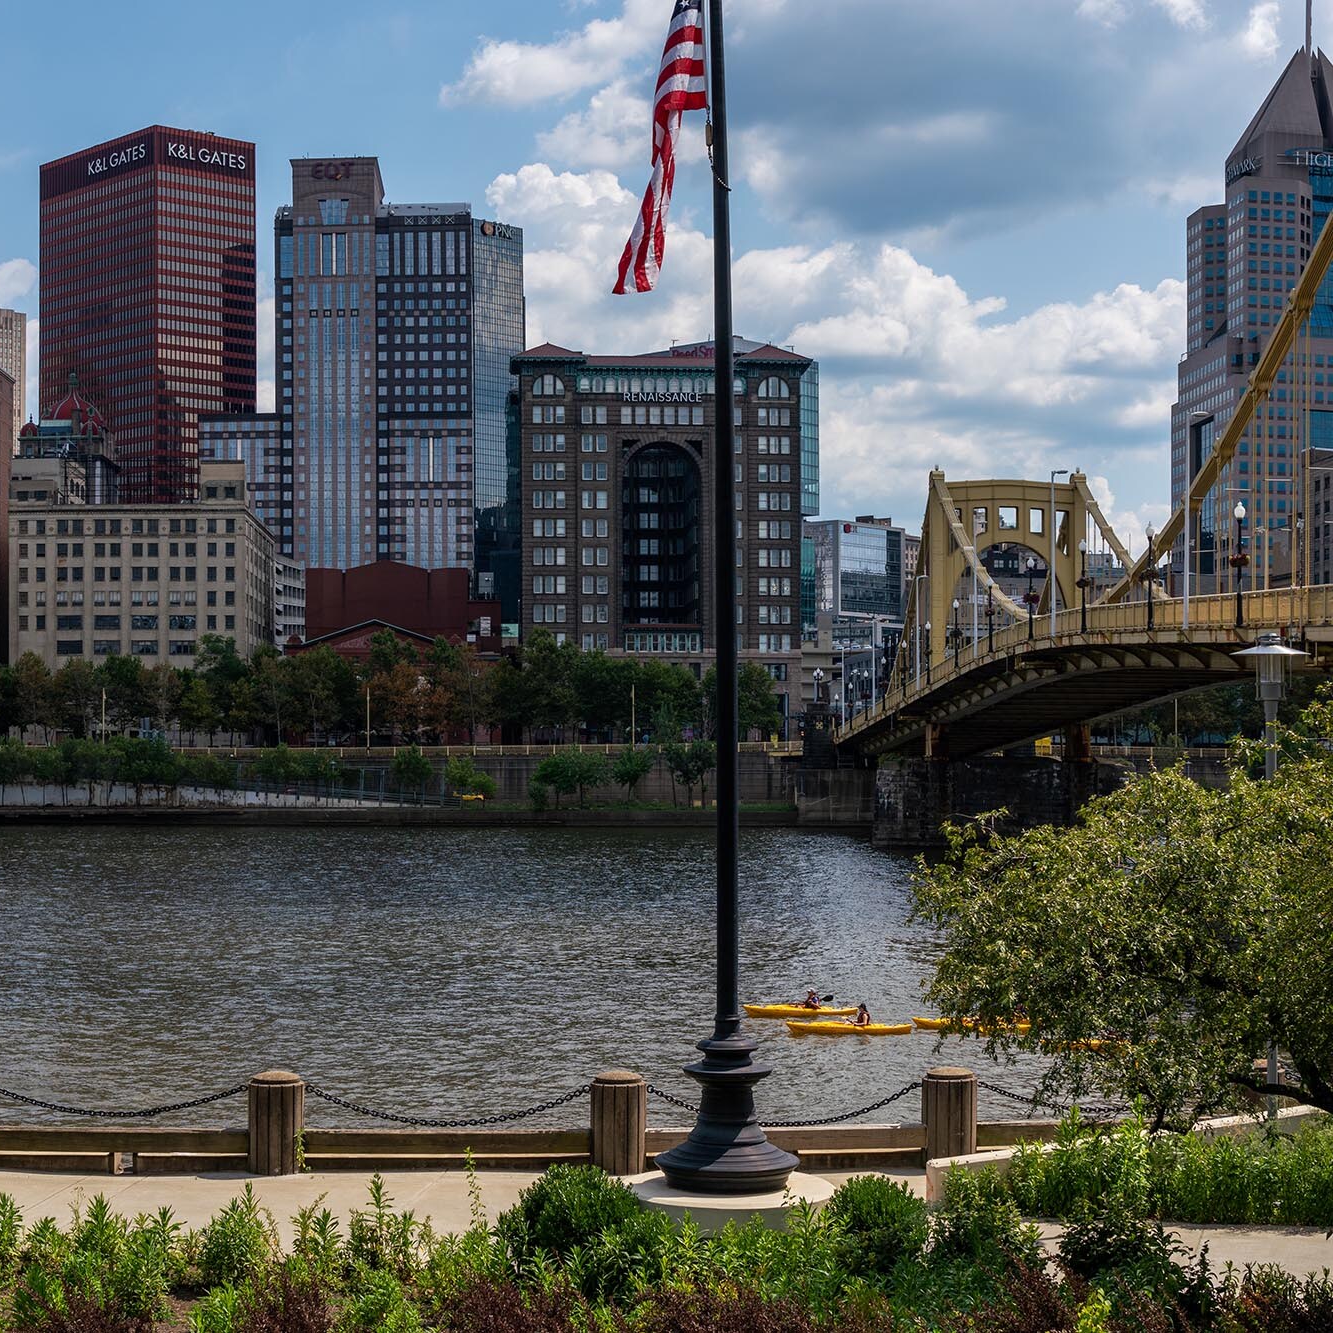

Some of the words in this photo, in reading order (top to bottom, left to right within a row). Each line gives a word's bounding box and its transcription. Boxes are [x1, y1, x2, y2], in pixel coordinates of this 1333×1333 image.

[88, 156, 108, 176] K&L
[109, 143, 146, 168] GATES
[168, 142, 196, 160] K&L
[198, 148, 246, 170] GATES
[311, 161, 354, 181] EQT
[495, 224, 515, 239] PNC
[623, 391, 702, 403] RENAISSANCE
